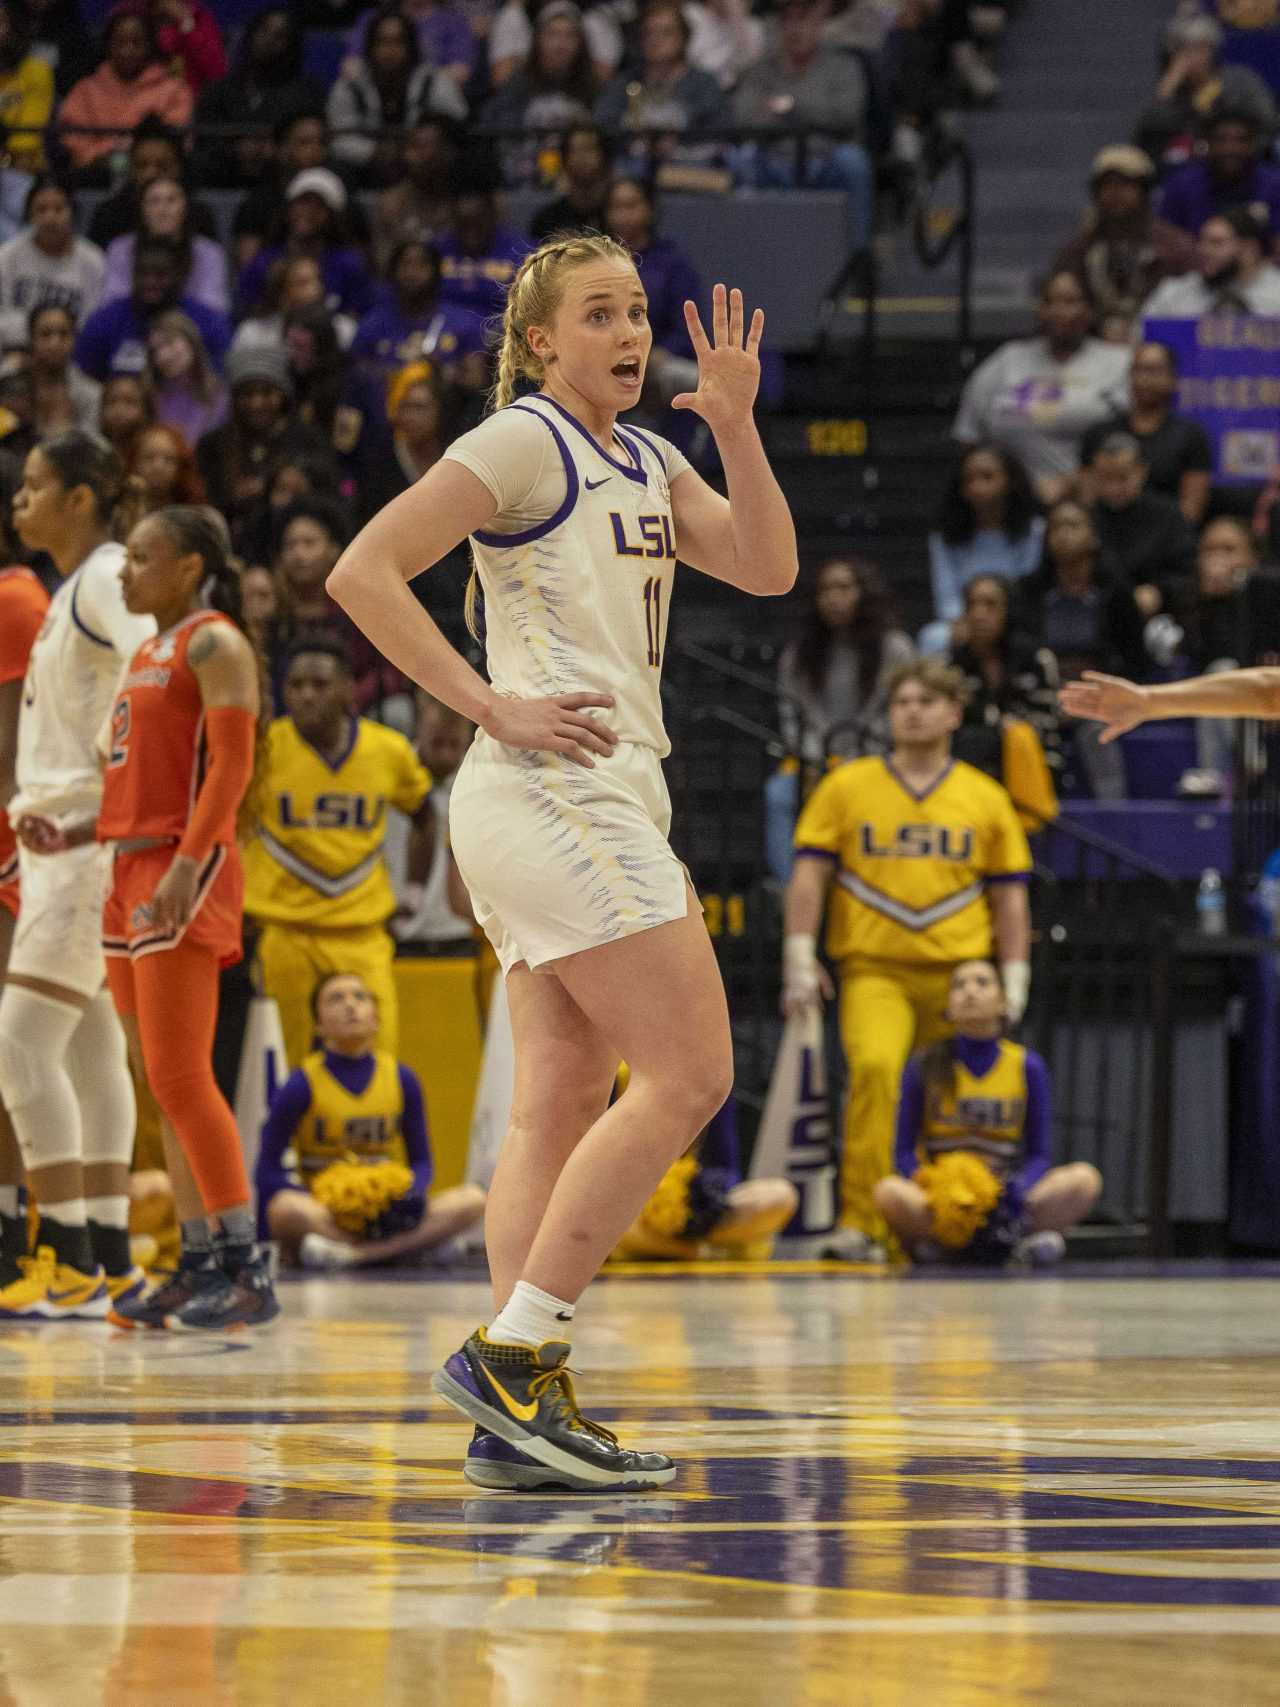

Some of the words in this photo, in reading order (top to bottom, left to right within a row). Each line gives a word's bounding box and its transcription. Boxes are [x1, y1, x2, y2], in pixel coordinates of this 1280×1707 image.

[643, 574, 663, 668] 11
[277, 791, 385, 830] LSU
[858, 822, 973, 861] LSU
[313, 1114, 402, 1147] LSU
